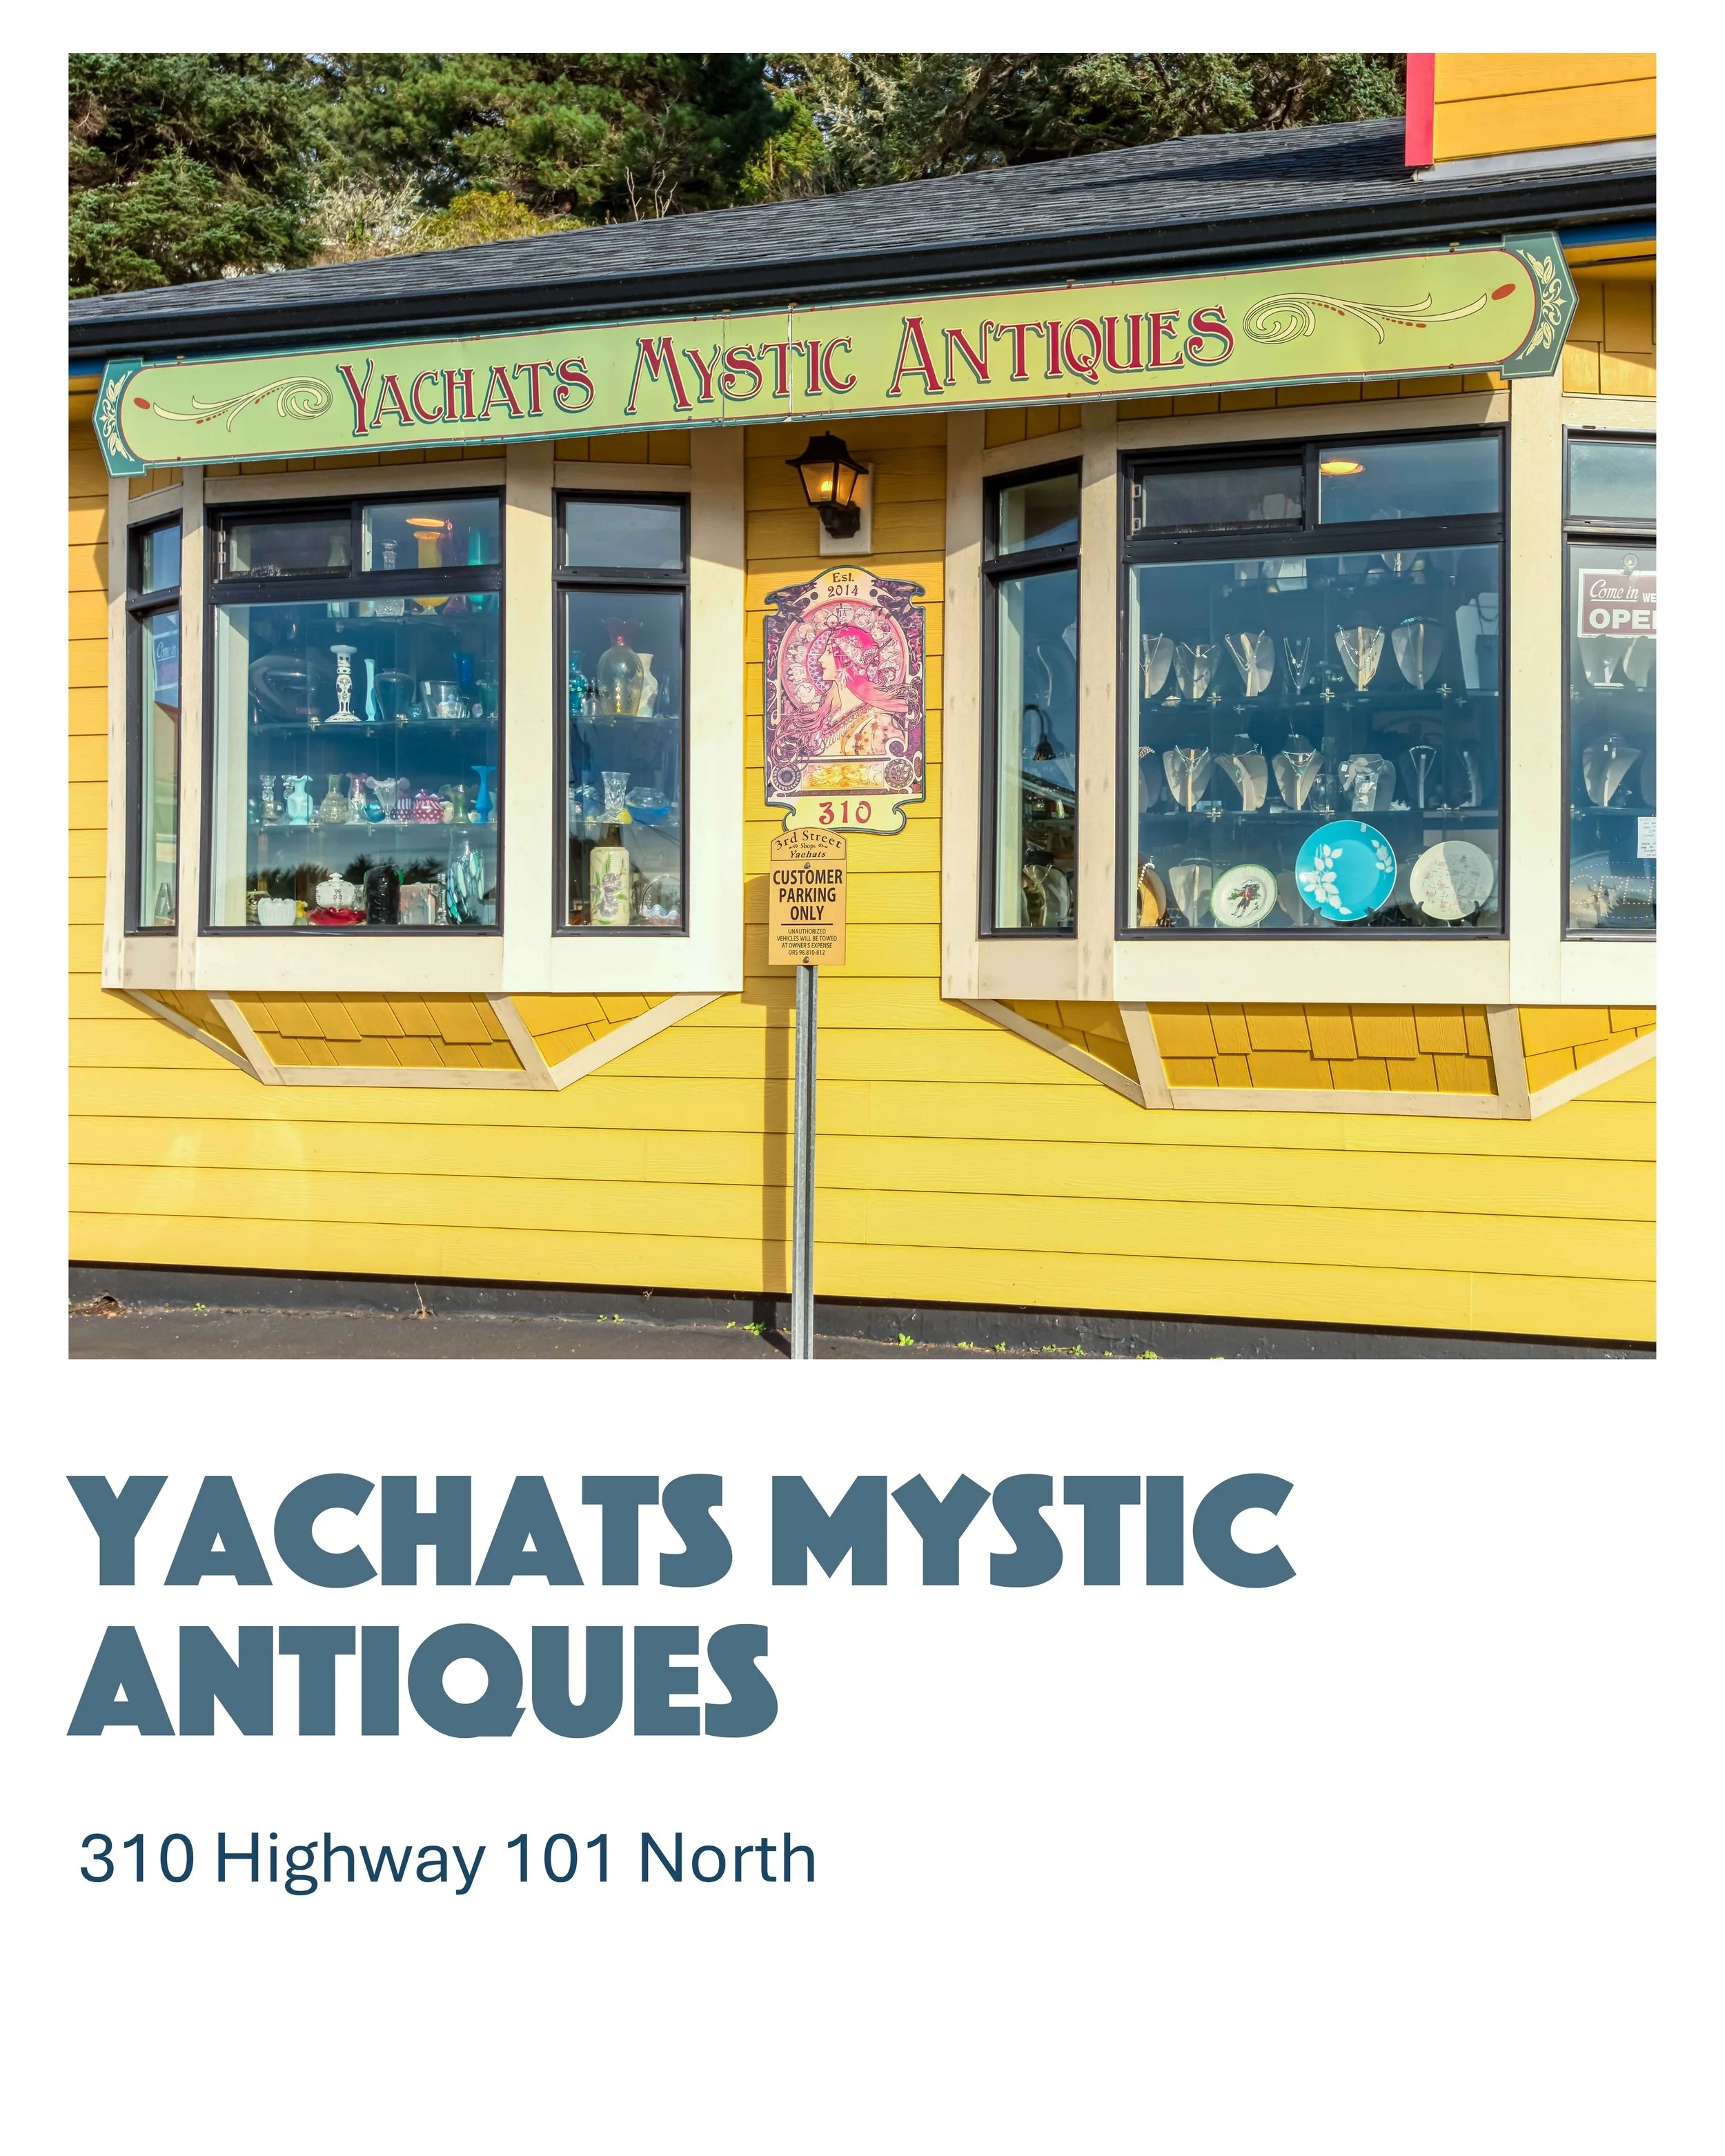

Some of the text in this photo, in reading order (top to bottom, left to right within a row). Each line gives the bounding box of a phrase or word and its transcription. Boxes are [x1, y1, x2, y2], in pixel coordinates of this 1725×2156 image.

[336, 304, 1235, 437] YACHATS MYSTIC ANTIQUES
[832, 572, 854, 583] Est.
[828, 584, 858, 597] 2014
[1590, 579, 1624, 599] Come
[1626, 586, 1639, 600] in
[1589, 608, 1656, 630] OPE
[819, 800, 871, 825] 310
[774, 830, 842, 850] 3rd Street
[790, 850, 827, 858] Yachats
[773, 869, 842, 885] CUSTOMER
[779, 887, 836, 903] PARKING
[790, 905, 825, 921] ONLY
